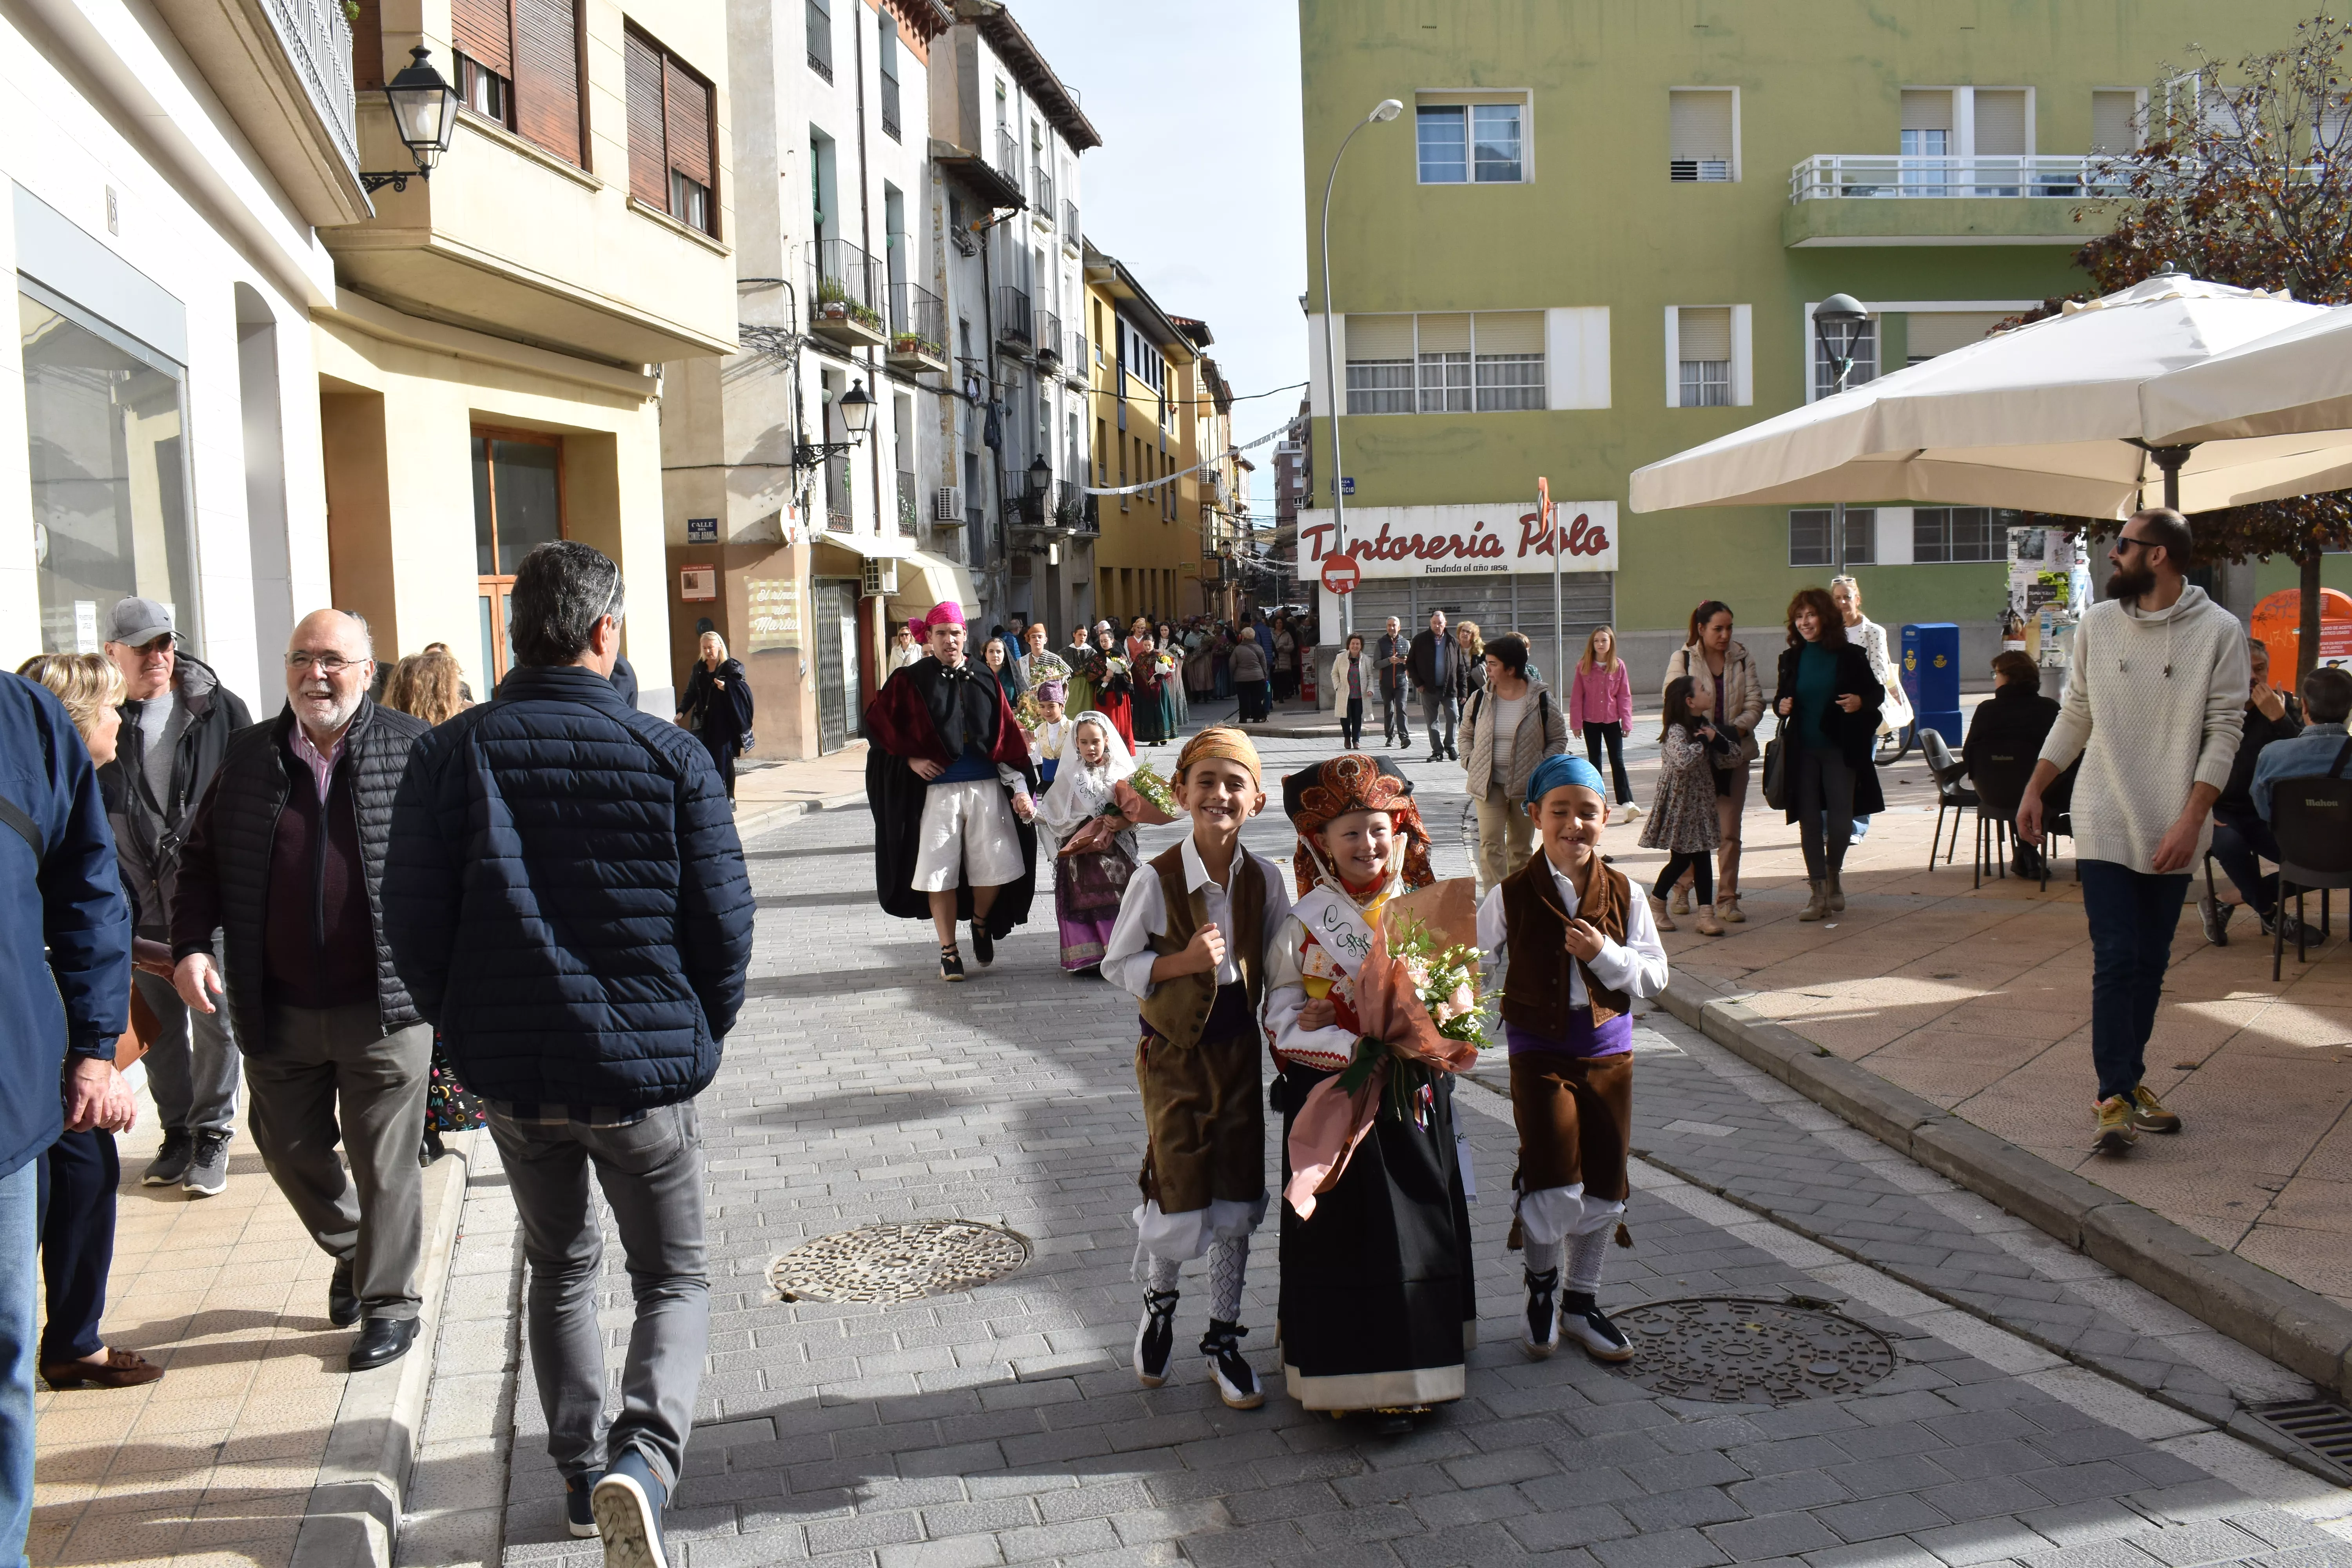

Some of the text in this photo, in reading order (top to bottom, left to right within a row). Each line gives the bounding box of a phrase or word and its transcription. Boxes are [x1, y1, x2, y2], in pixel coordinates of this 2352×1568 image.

[1517, 513, 1610, 558] Polo
[1425, 564, 1461, 573] Fundada
[1464, 563, 1472, 572] el
[757, 589, 770, 601] El
[774, 604, 786, 615] de
